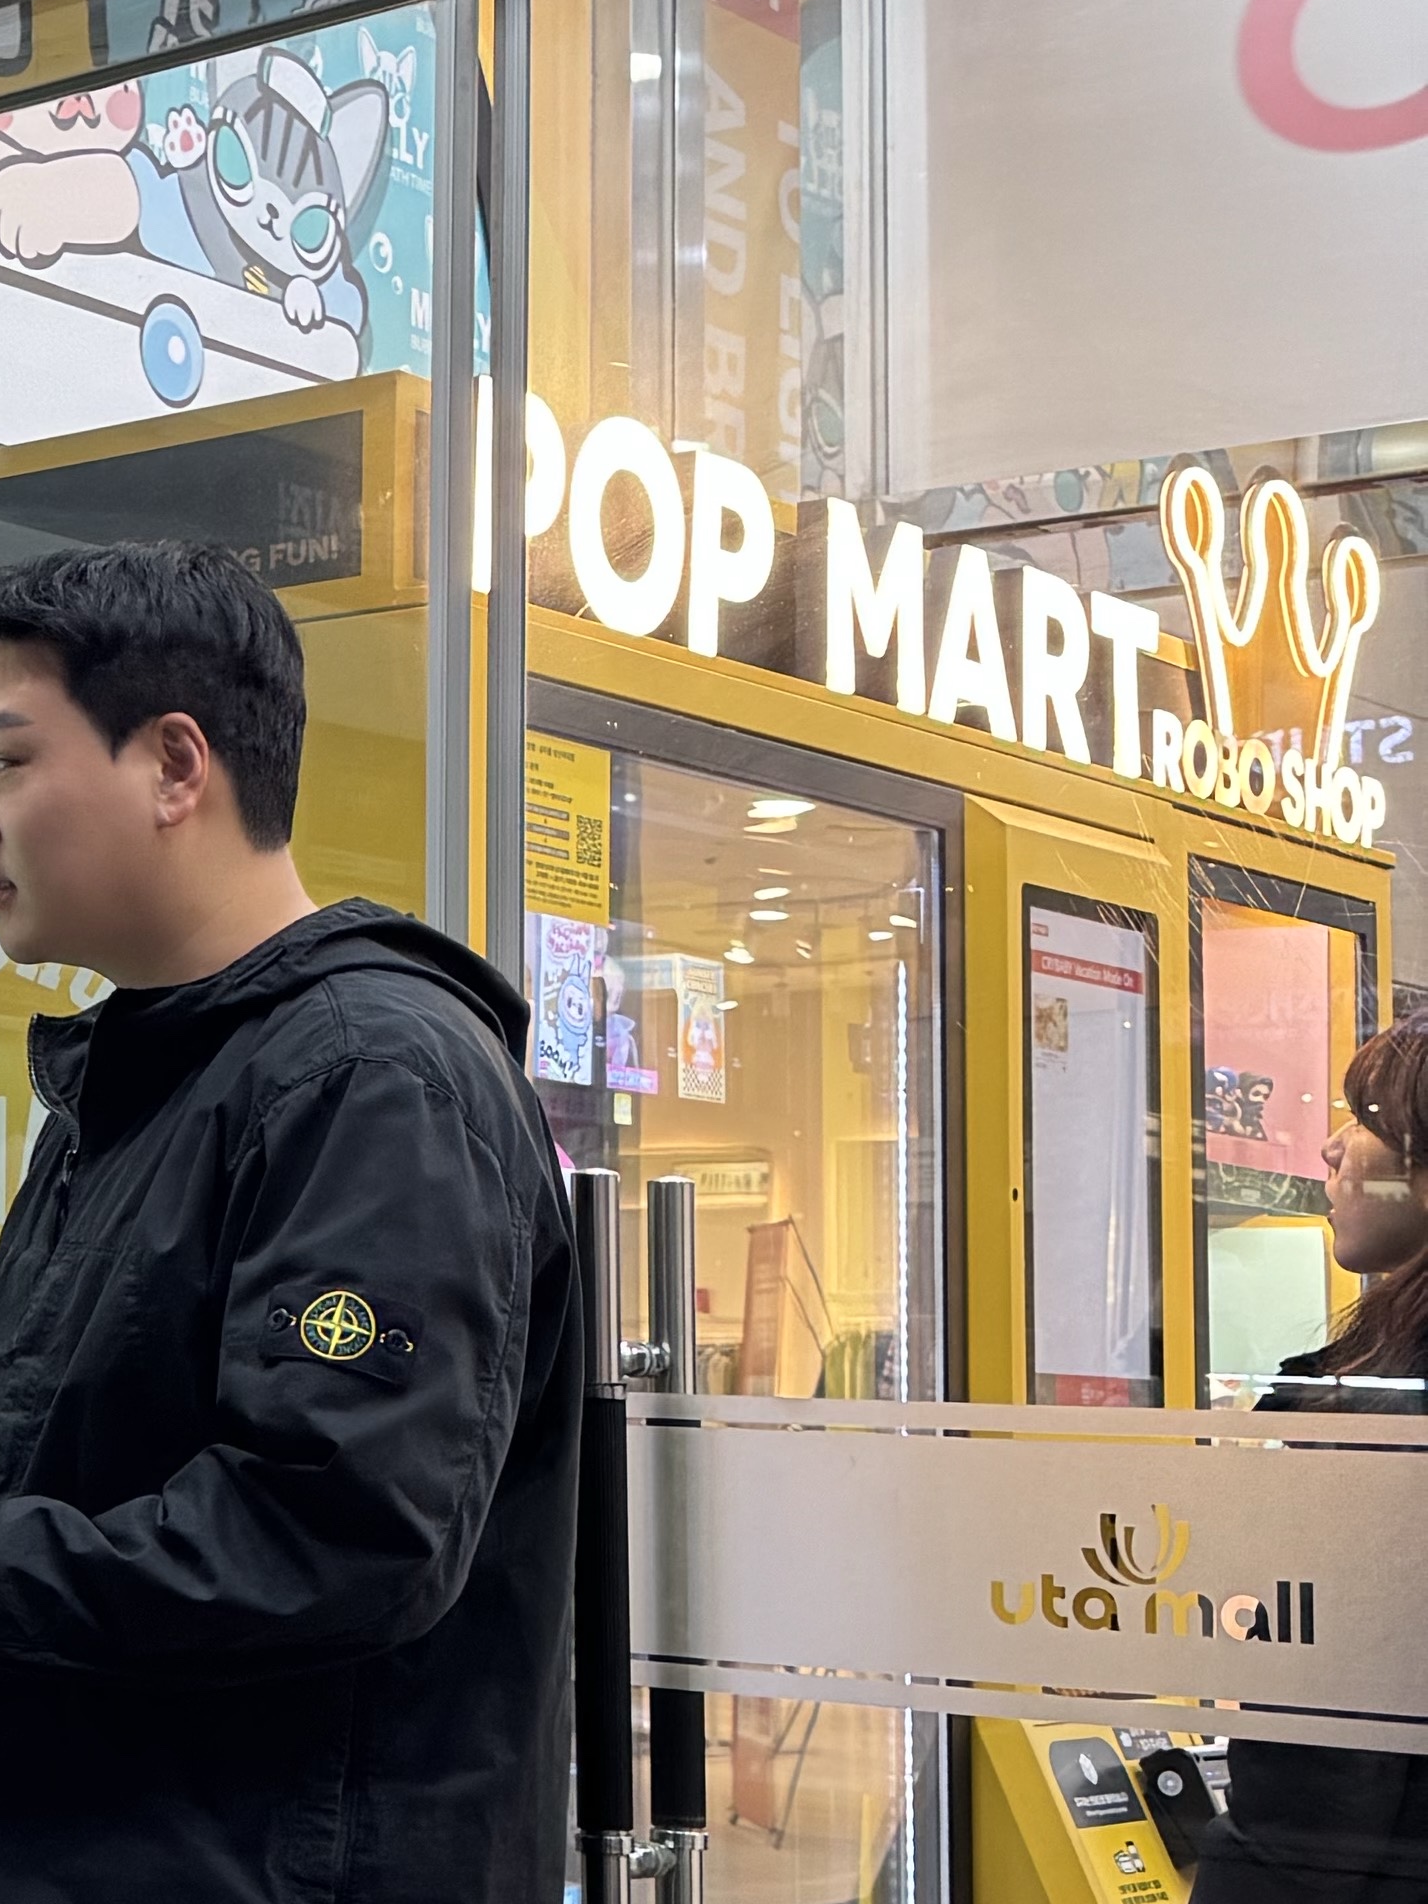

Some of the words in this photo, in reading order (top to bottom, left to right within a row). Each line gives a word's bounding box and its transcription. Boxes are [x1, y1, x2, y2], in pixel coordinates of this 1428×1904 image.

[268, 536, 341, 573] FUN!
[473, 374, 776, 658] POP
[825, 497, 1161, 781] MART
[1152, 708, 1276, 815] ROBO
[1281, 748, 1387, 849] SHOP
[990, 1573, 1121, 1632] uta
[1145, 1580, 1316, 1646] mall
